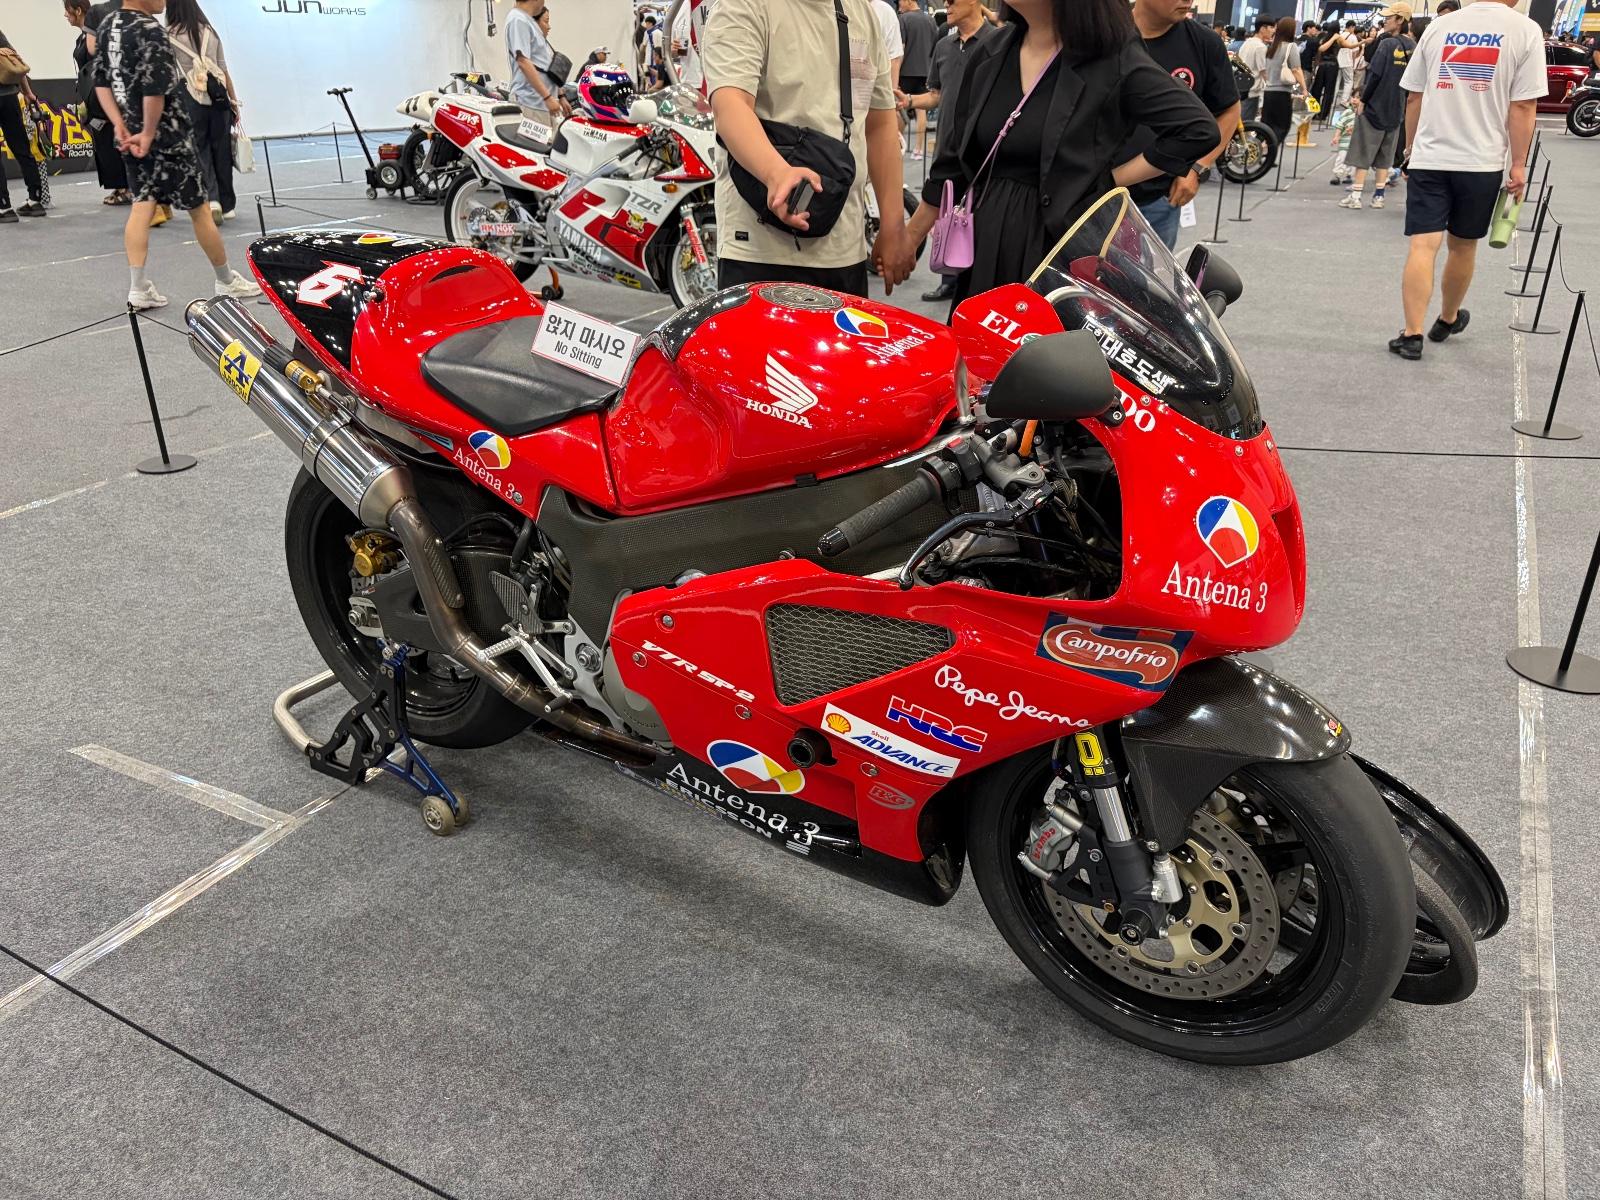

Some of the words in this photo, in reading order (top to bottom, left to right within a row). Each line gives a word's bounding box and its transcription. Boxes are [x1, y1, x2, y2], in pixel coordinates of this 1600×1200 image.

[1445, 32, 1504, 47] KODAK
[1437, 82, 1453, 90] Film
[68, 149, 94, 157] Racing
[583, 130, 607, 142] YAMAHA
[631, 192, 663, 215] TZR
[559, 221, 602, 261] YAMAHA
[546, 315, 577, 341] 앉지
[579, 326, 625, 359] 마시오
[978, 309, 1022, 345] EL
[554, 340, 568, 355] No
[570, 346, 602, 369] Sitting
[857, 335, 927, 359] Antena
[1101, 335, 1174, 395] 대호도색
[746, 397, 813, 429] HONDA
[453, 447, 503, 491] Antena
[505, 483, 516, 500] 3
[1161, 561, 1252, 610] Antena
[1255, 582, 1268, 613] 3
[1055, 629, 1167, 668] Campofrío
[641, 639, 698, 673] VTR
[697, 671, 756, 702] SP-2
[934, 664, 1001, 706] Pepe
[998, 690, 1093, 728] Jeans
[870, 730, 890, 741] Shell
[886, 695, 988, 752] HRC
[850, 733, 953, 774] ADVANCE
[665, 779, 772, 839] ERICSSON
[667, 762, 789, 833] Antena
[793, 821, 821, 846] 3
[1033, 827, 1056, 860] brembo
